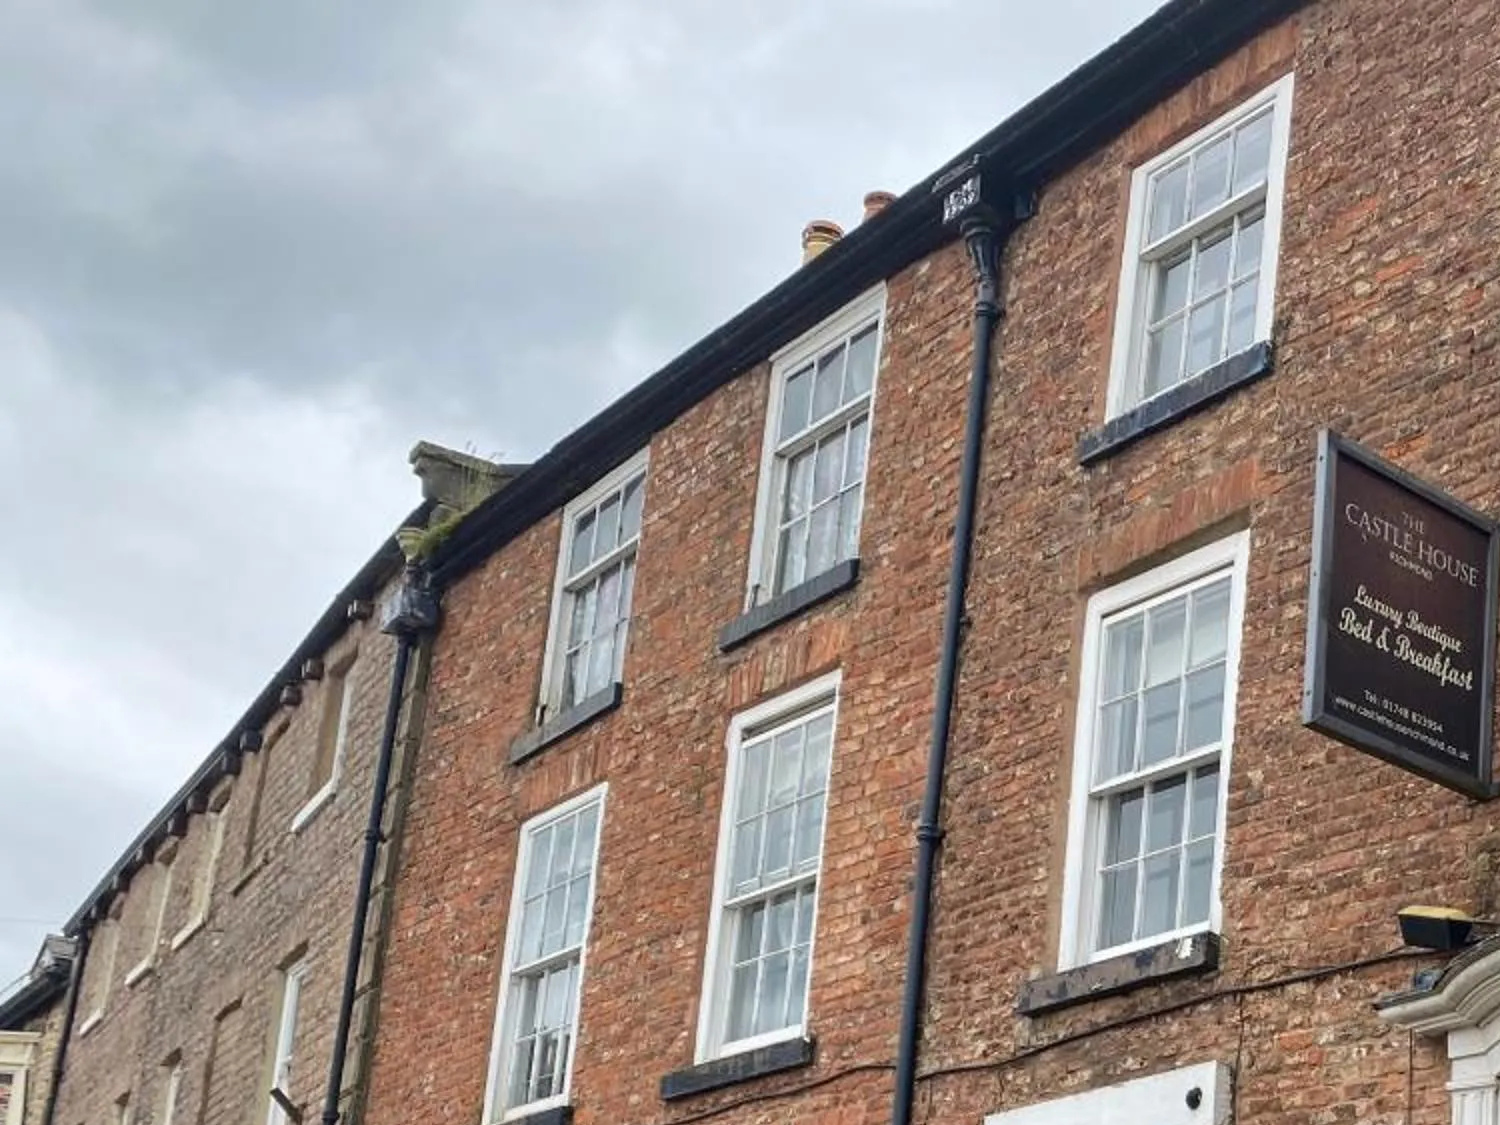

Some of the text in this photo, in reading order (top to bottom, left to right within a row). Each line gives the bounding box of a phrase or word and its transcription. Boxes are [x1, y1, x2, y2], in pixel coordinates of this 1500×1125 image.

[1345, 503, 1479, 588] CASTLE HOUSE
[1402, 511, 1425, 535] THE
[1339, 607, 1474, 691] Bed & Breakfast
[1354, 584, 1463, 653] Luxury Boutique
